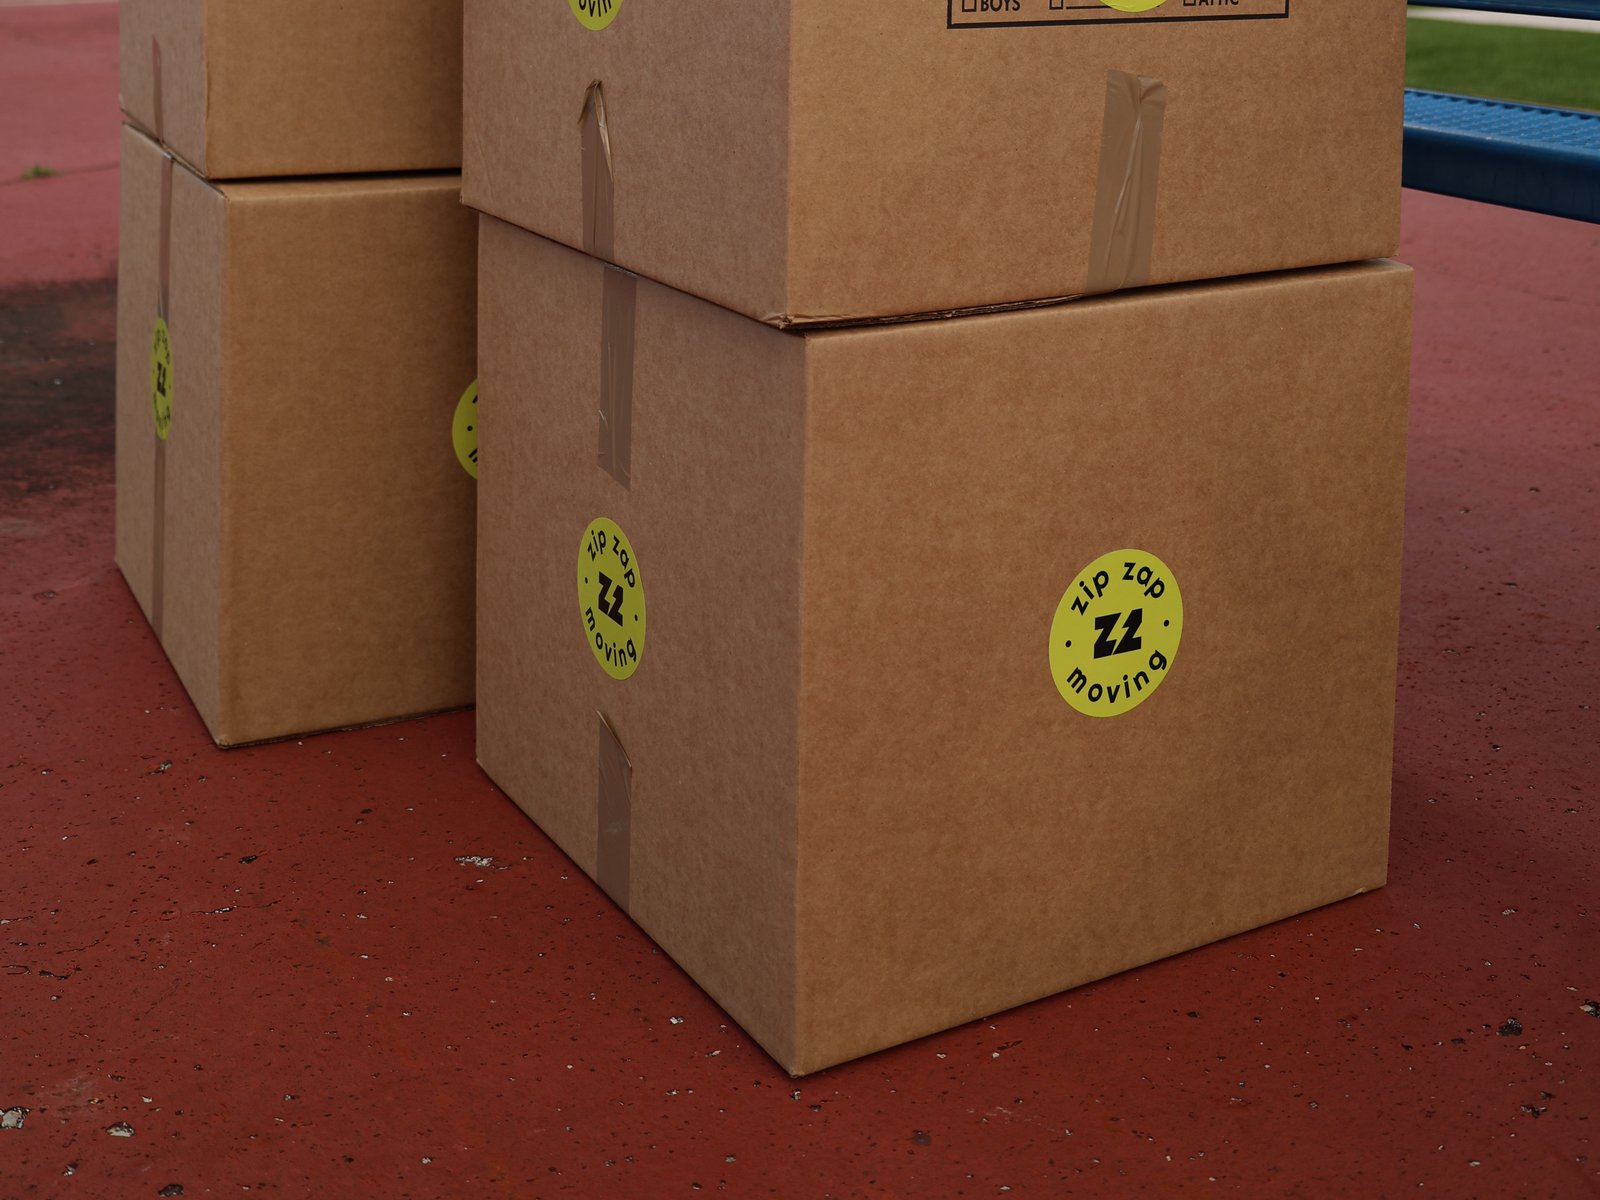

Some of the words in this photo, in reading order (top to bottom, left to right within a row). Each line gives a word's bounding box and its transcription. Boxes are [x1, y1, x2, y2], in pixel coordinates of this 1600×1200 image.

[587, 529, 607, 562] zip
[612, 535, 636, 588] zap
[1071, 570, 1109, 616] zip
[1122, 562, 1165, 599] zap
[585, 606, 637, 667] moving
[1066, 649, 1168, 704] moving
